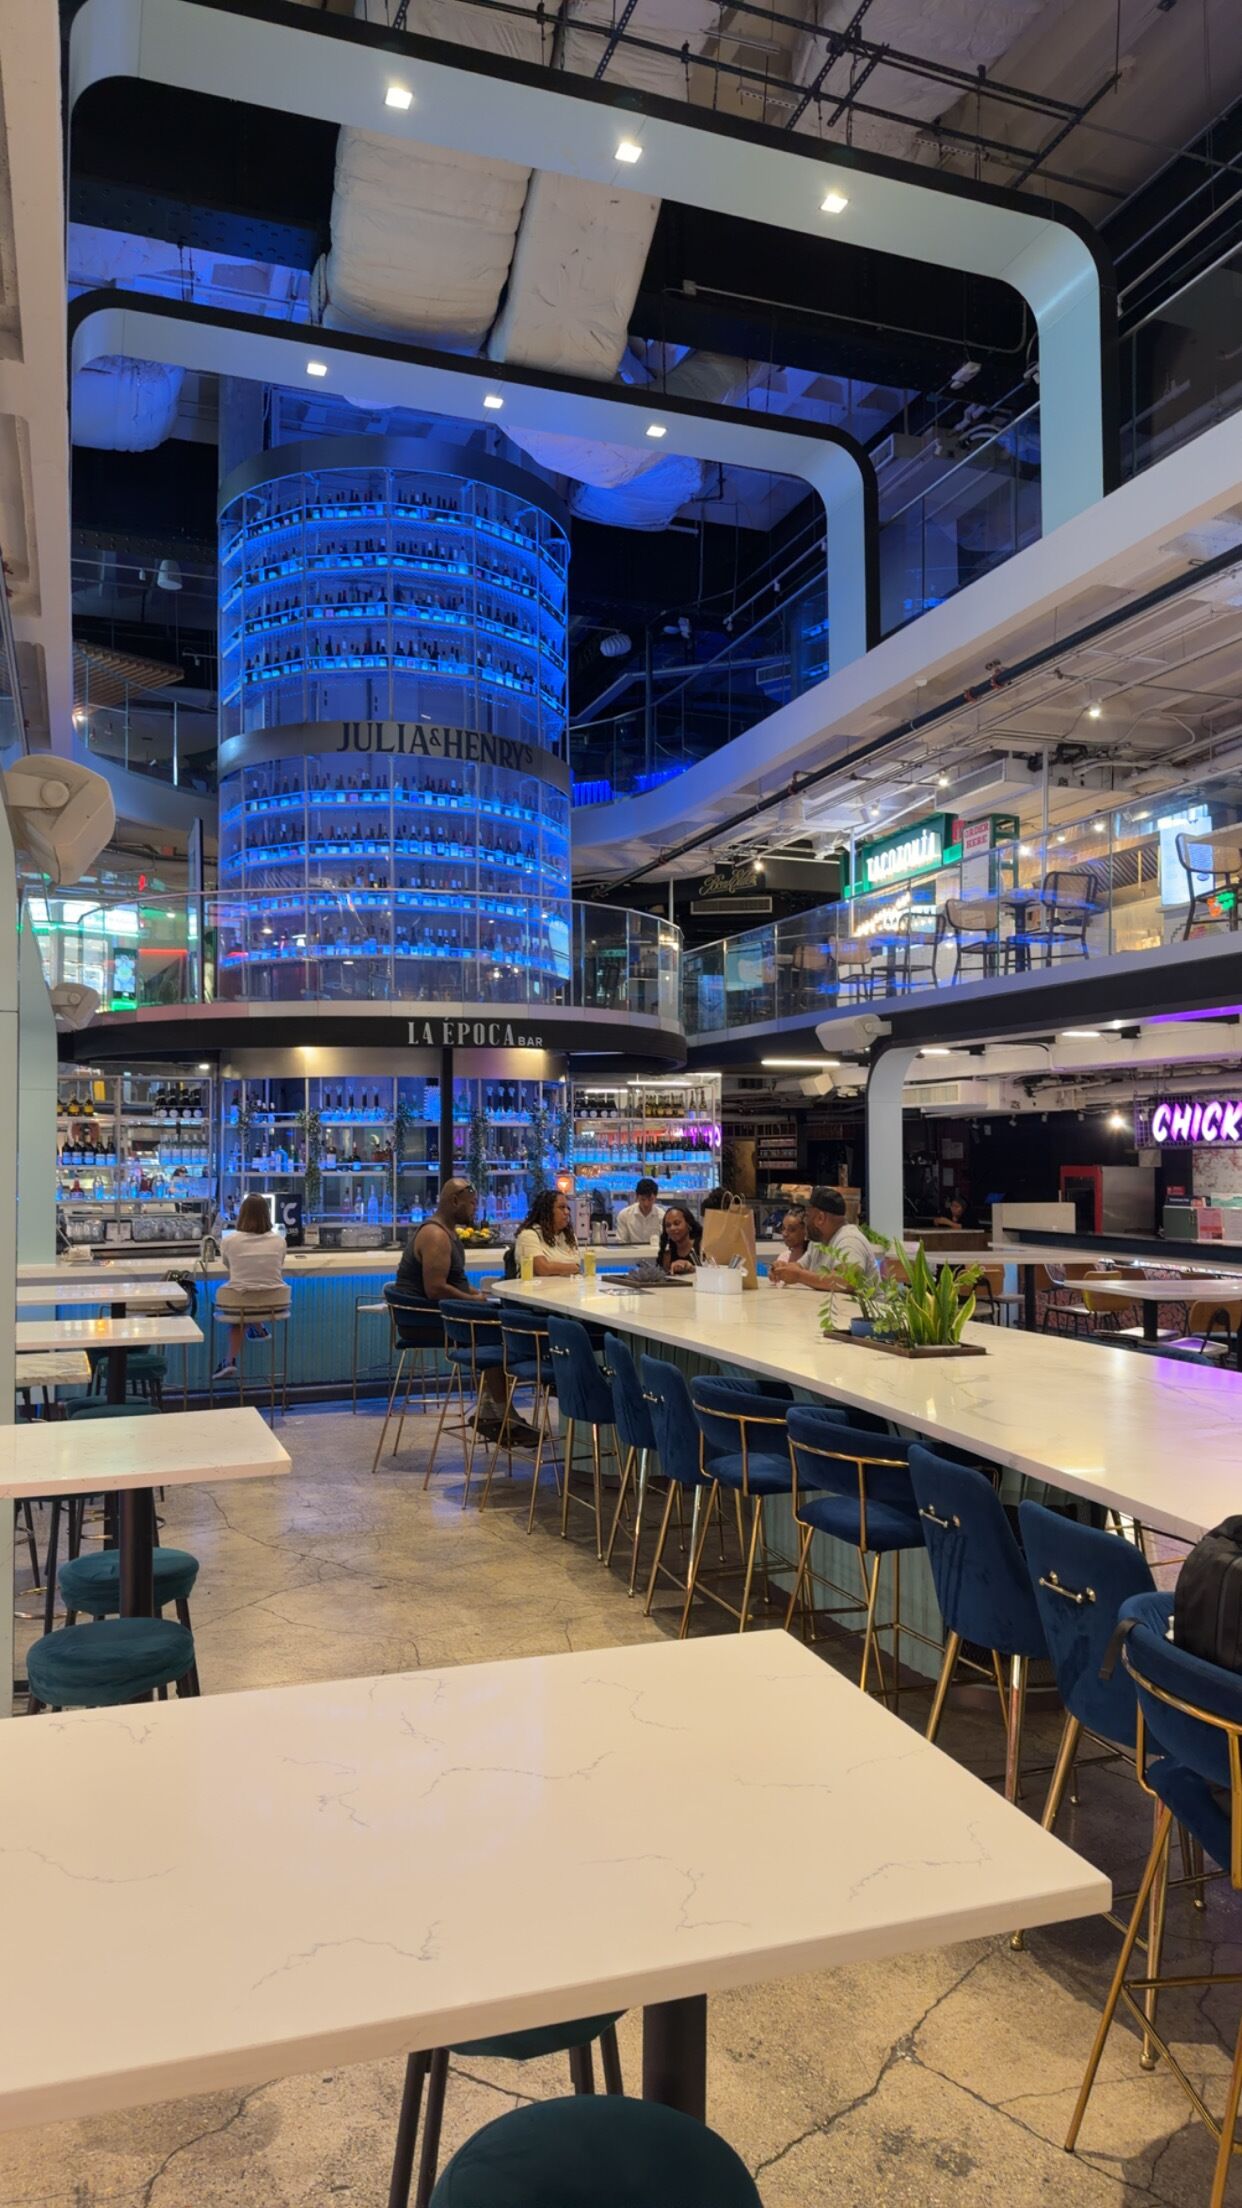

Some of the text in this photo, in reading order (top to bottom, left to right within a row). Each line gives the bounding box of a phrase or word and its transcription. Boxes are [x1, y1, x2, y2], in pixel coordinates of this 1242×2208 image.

[408, 1017, 543, 1047] LA ÉPOCA BAR
[1152, 1101, 1242, 1142] CHICK
